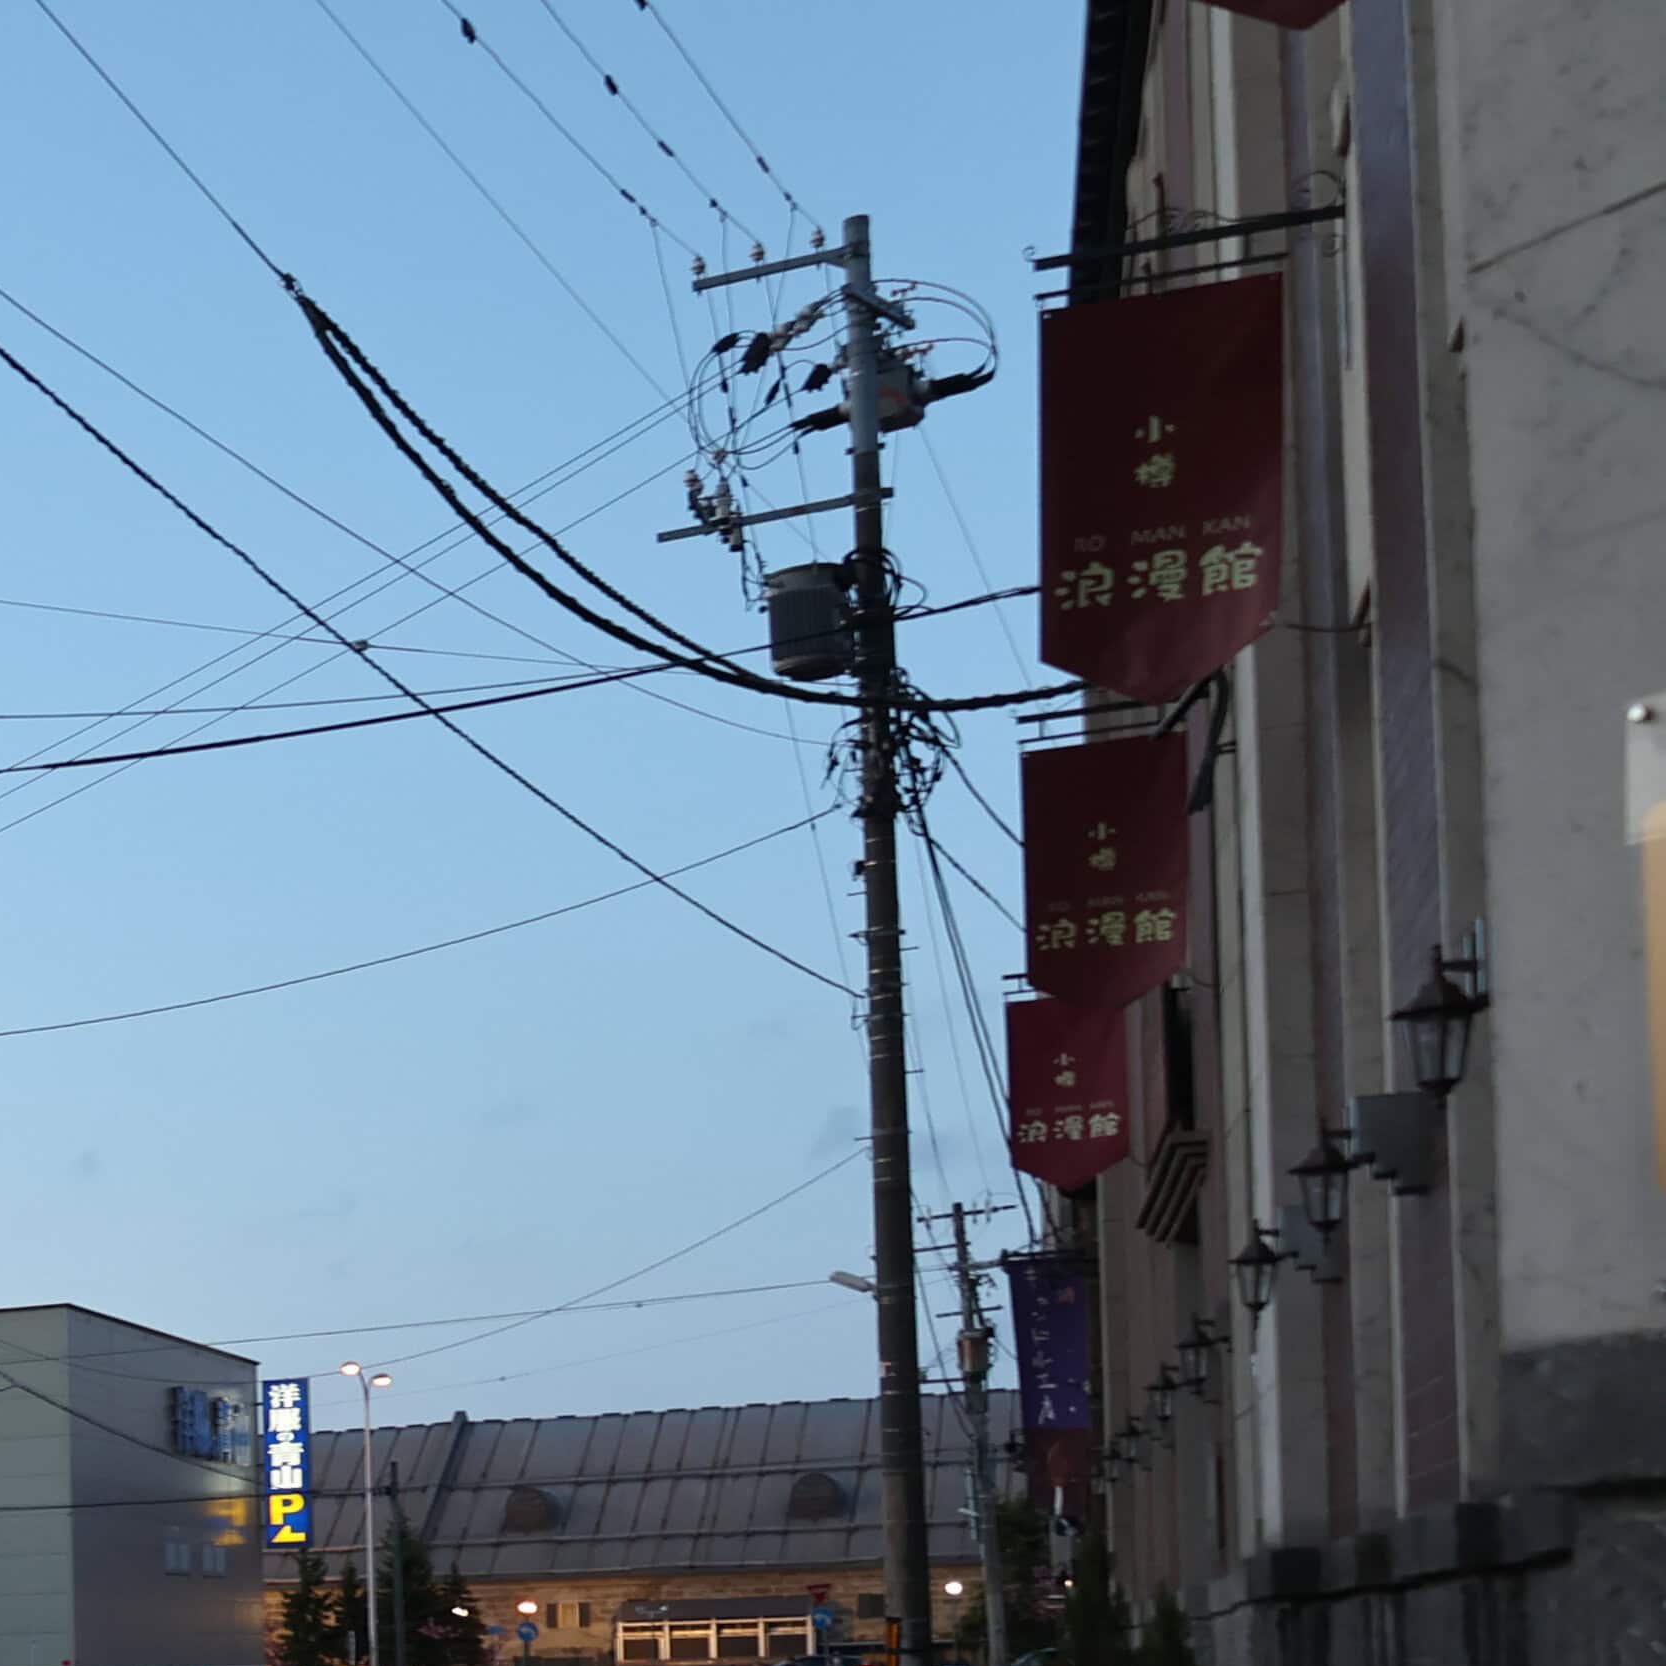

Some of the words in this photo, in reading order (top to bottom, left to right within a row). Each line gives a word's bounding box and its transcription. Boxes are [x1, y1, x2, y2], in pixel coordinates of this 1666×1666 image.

[1133, 414, 1177, 488] 小樽
[1131, 523, 1188, 546] MAN
[1202, 513, 1252, 536] KAN
[1054, 540, 1264, 611] 浪漫館
[1034, 907, 1178, 952] 浪漫館
[1017, 1111, 1123, 1145] 浪漫館
[269, 1492, 305, 1526] P
